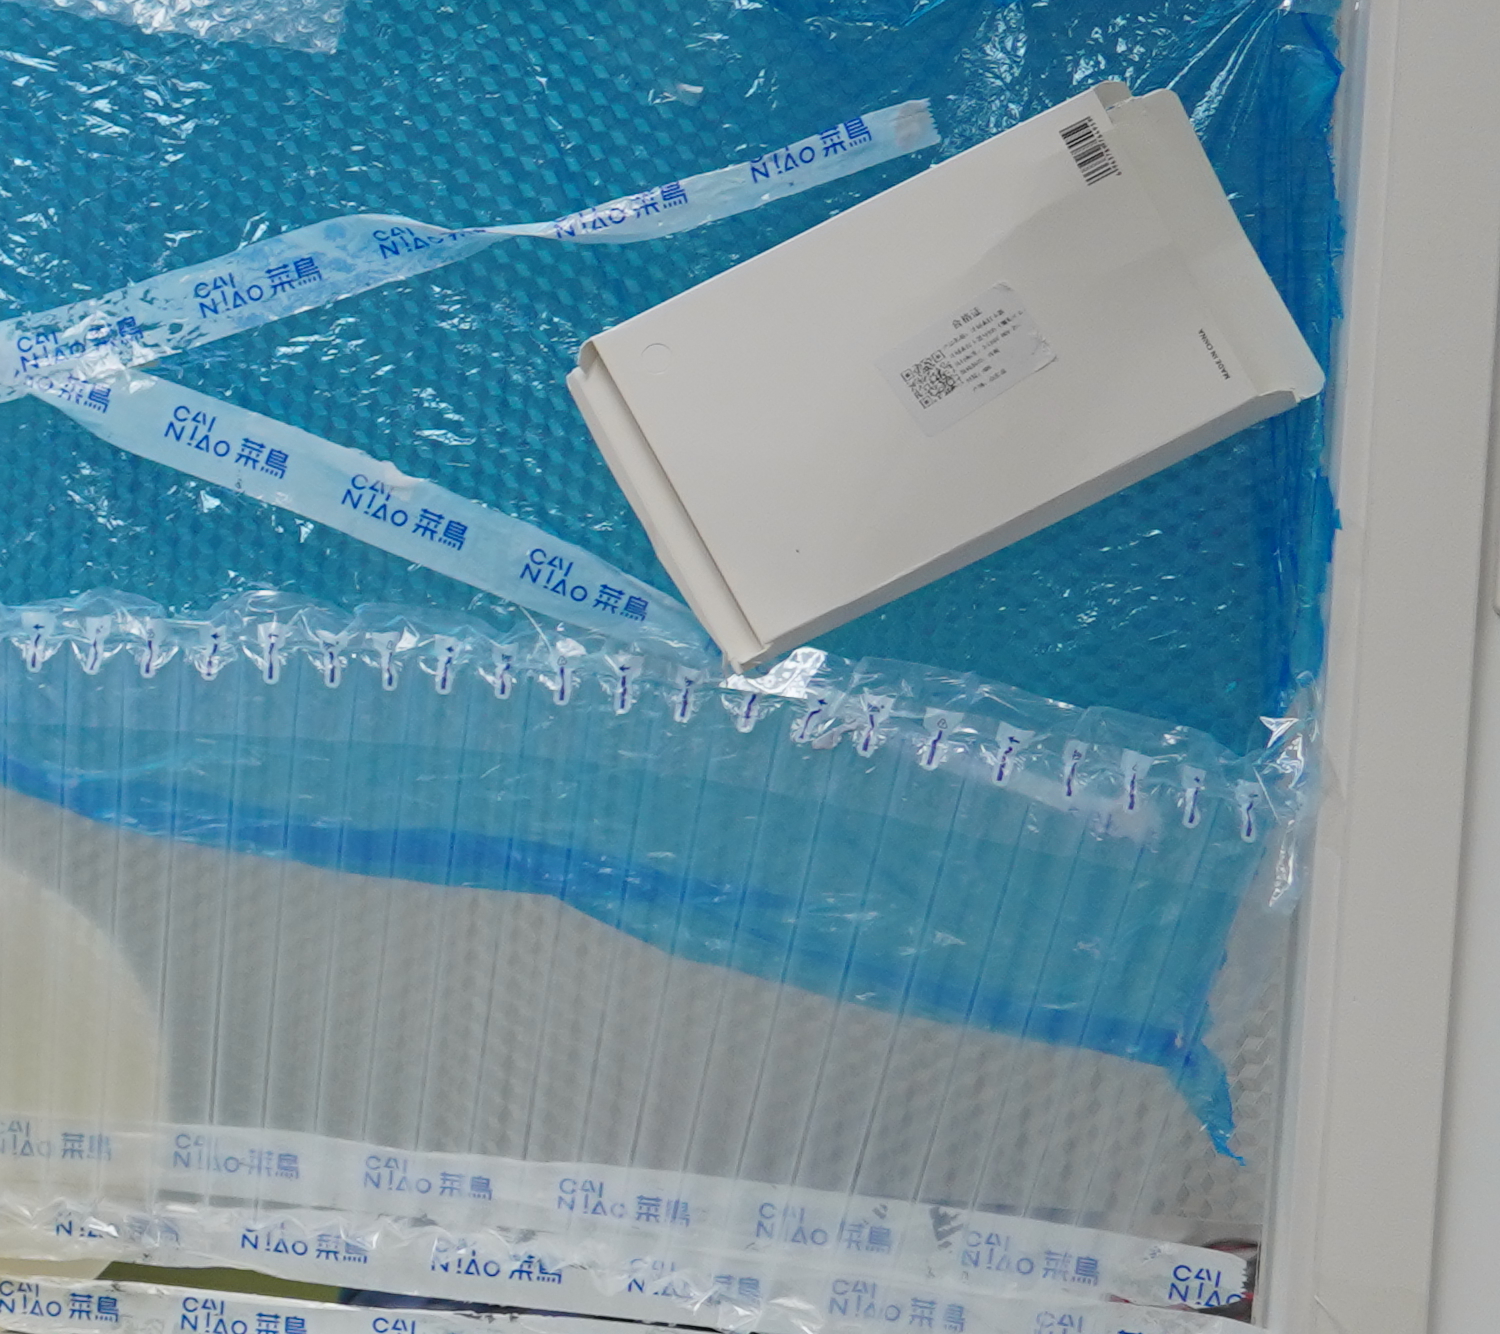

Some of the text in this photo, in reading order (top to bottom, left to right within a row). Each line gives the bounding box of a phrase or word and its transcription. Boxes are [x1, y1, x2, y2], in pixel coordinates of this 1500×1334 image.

[195, 272, 237, 299] CAI
[266, 255, 323, 296] 菜鳥
[200, 283, 265, 319] NIAO
[952, 307, 983, 330] 合格证
[1215, 359, 1231, 380] MADE
[173, 404, 216, 431] CAI
[165, 419, 232, 458] NIAO
[236, 437, 291, 479] 菜鳥
[342, 485, 409, 529] NIAO
[412, 507, 469, 551] 菜鳥
[529, 547, 575, 577] CAI
[520, 561, 589, 602] NIAO
[592, 583, 650, 622] 菜鳥
[366, 1154, 409, 1171] CAI
[439, 1172, 493, 1201] 菜鳥
[558, 1177, 604, 1198] CAI
[240, 1228, 308, 1257] NIAO
[1045, 1249, 1100, 1286] 菜鳥
[1172, 1264, 1222, 1288] CAI
[0, 1279, 41, 1299] CAI
[831, 1278, 877, 1297] CAI
[69, 1291, 120, 1323] 菜鳥
[182, 1296, 225, 1317] CAI
[910, 1297, 966, 1333] 菜鳥
